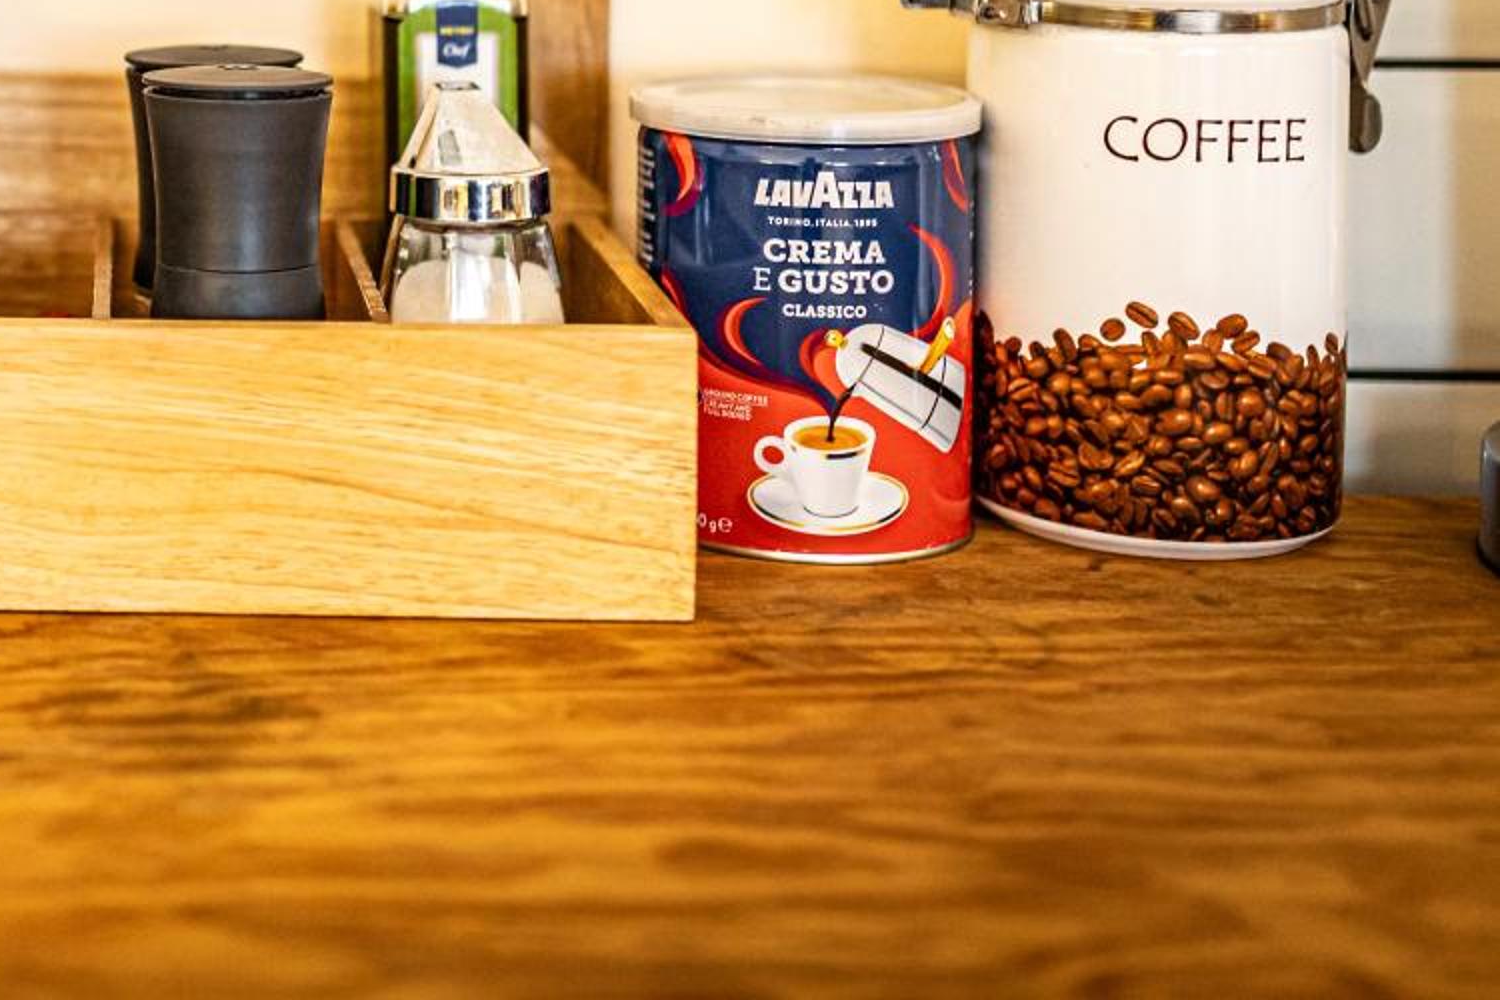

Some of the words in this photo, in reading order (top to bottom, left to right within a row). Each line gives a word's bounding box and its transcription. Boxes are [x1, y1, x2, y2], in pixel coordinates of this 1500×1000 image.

[1104, 115, 1307, 163] COFFEE
[754, 171, 894, 209] LAVAZZA
[763, 238, 886, 265] CREMA
[752, 266, 772, 291] E
[778, 268, 894, 295] GUSTO
[782, 303, 867, 319] CLASSICO
